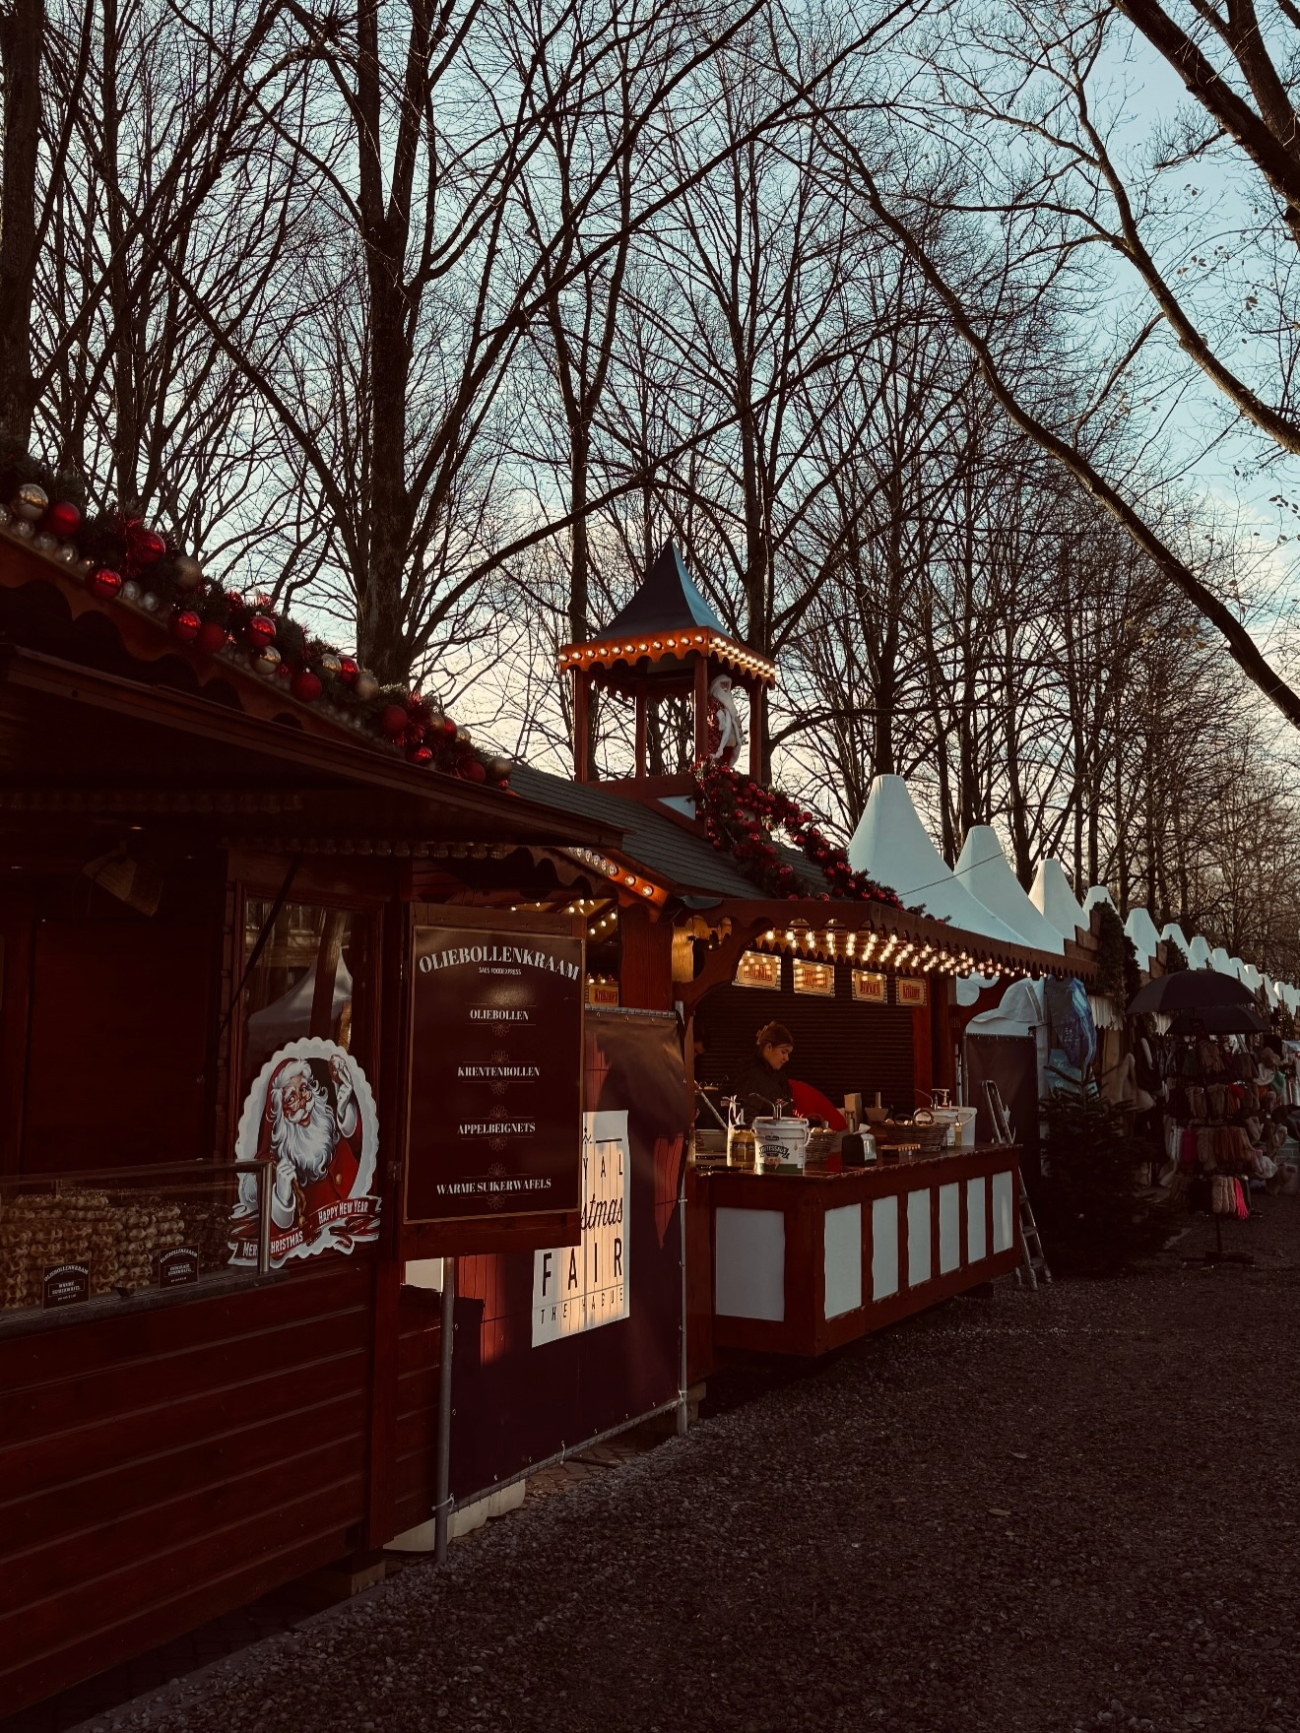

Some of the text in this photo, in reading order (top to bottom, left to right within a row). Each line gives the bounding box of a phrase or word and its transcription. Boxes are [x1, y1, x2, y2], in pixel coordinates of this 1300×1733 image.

[418, 945, 580, 982] OLIEBOLLENKRAAM
[469, 1008, 530, 1021] OLIEBOLLEN
[457, 1066, 540, 1078] KRENTENBOLLEN
[457, 1122, 536, 1135] APPELBEIGNETS
[583, 1154, 623, 1180] YAL
[436, 1178, 552, 1195] WARME SUIKERWAFELS
[317, 1199, 369, 1225] HAPPY NEW YEAR
[581, 1193, 623, 1231] stmas
[242, 1231, 304, 1258] MER HRISTMAS
[541, 1238, 623, 1297] FAIR
[540, 1287, 624, 1325] THE HAGUE
